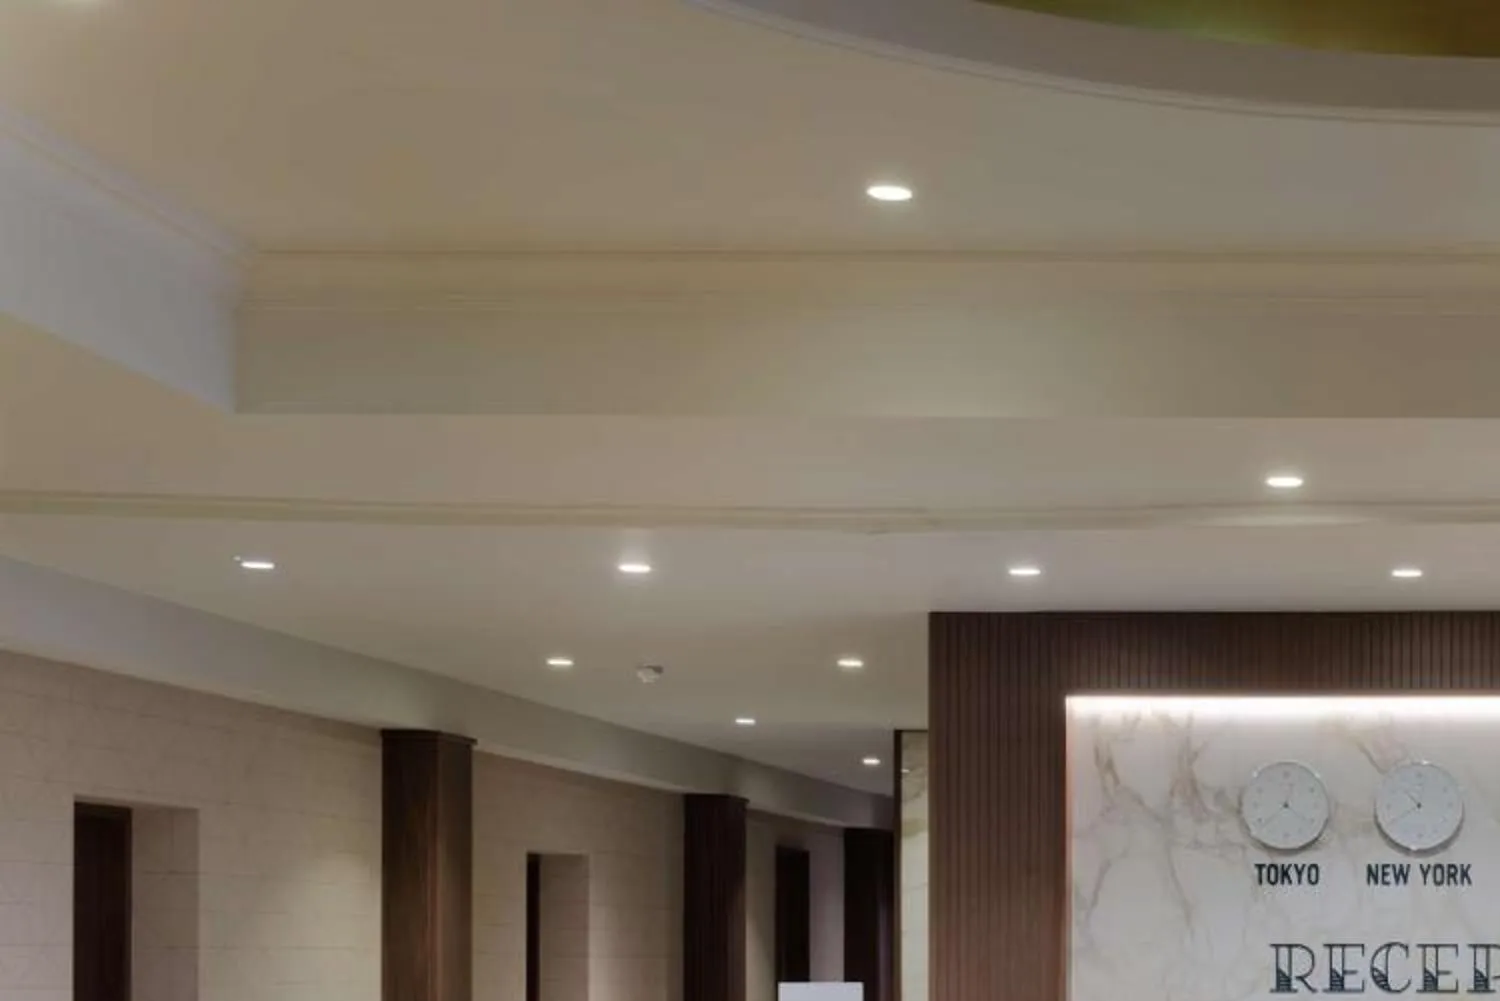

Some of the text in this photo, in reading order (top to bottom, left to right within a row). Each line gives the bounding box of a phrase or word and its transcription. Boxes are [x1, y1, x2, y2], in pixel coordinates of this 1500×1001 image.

[1254, 863, 1320, 886] TOKYO
[1366, 863, 1472, 886] NEW YORK
